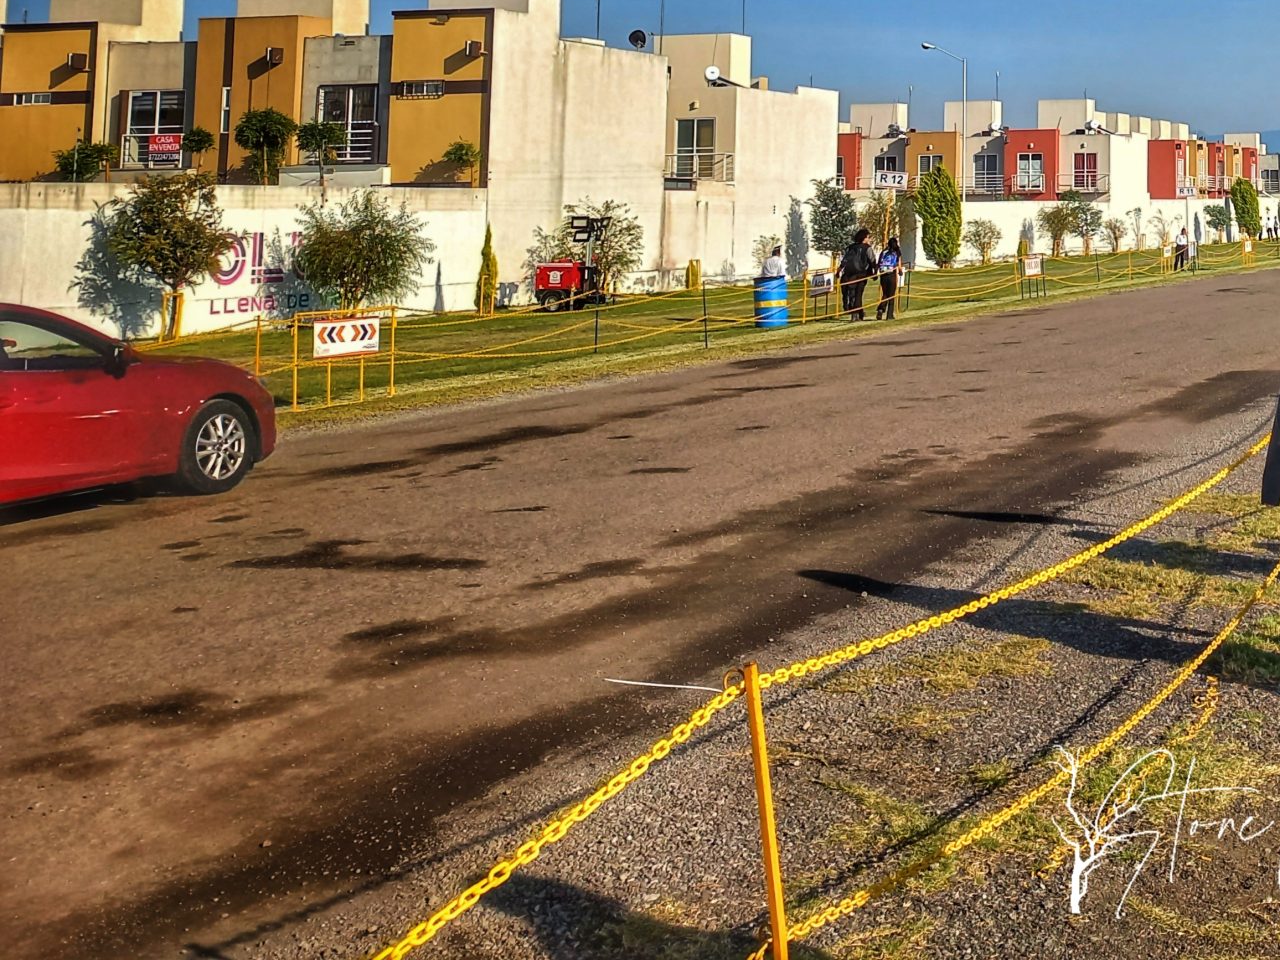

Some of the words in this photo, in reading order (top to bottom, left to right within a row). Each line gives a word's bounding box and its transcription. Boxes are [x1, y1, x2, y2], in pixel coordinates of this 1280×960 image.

[155, 136, 174, 144] CASA
[880, 173, 888, 183] R
[891, 174, 904, 185] 12
